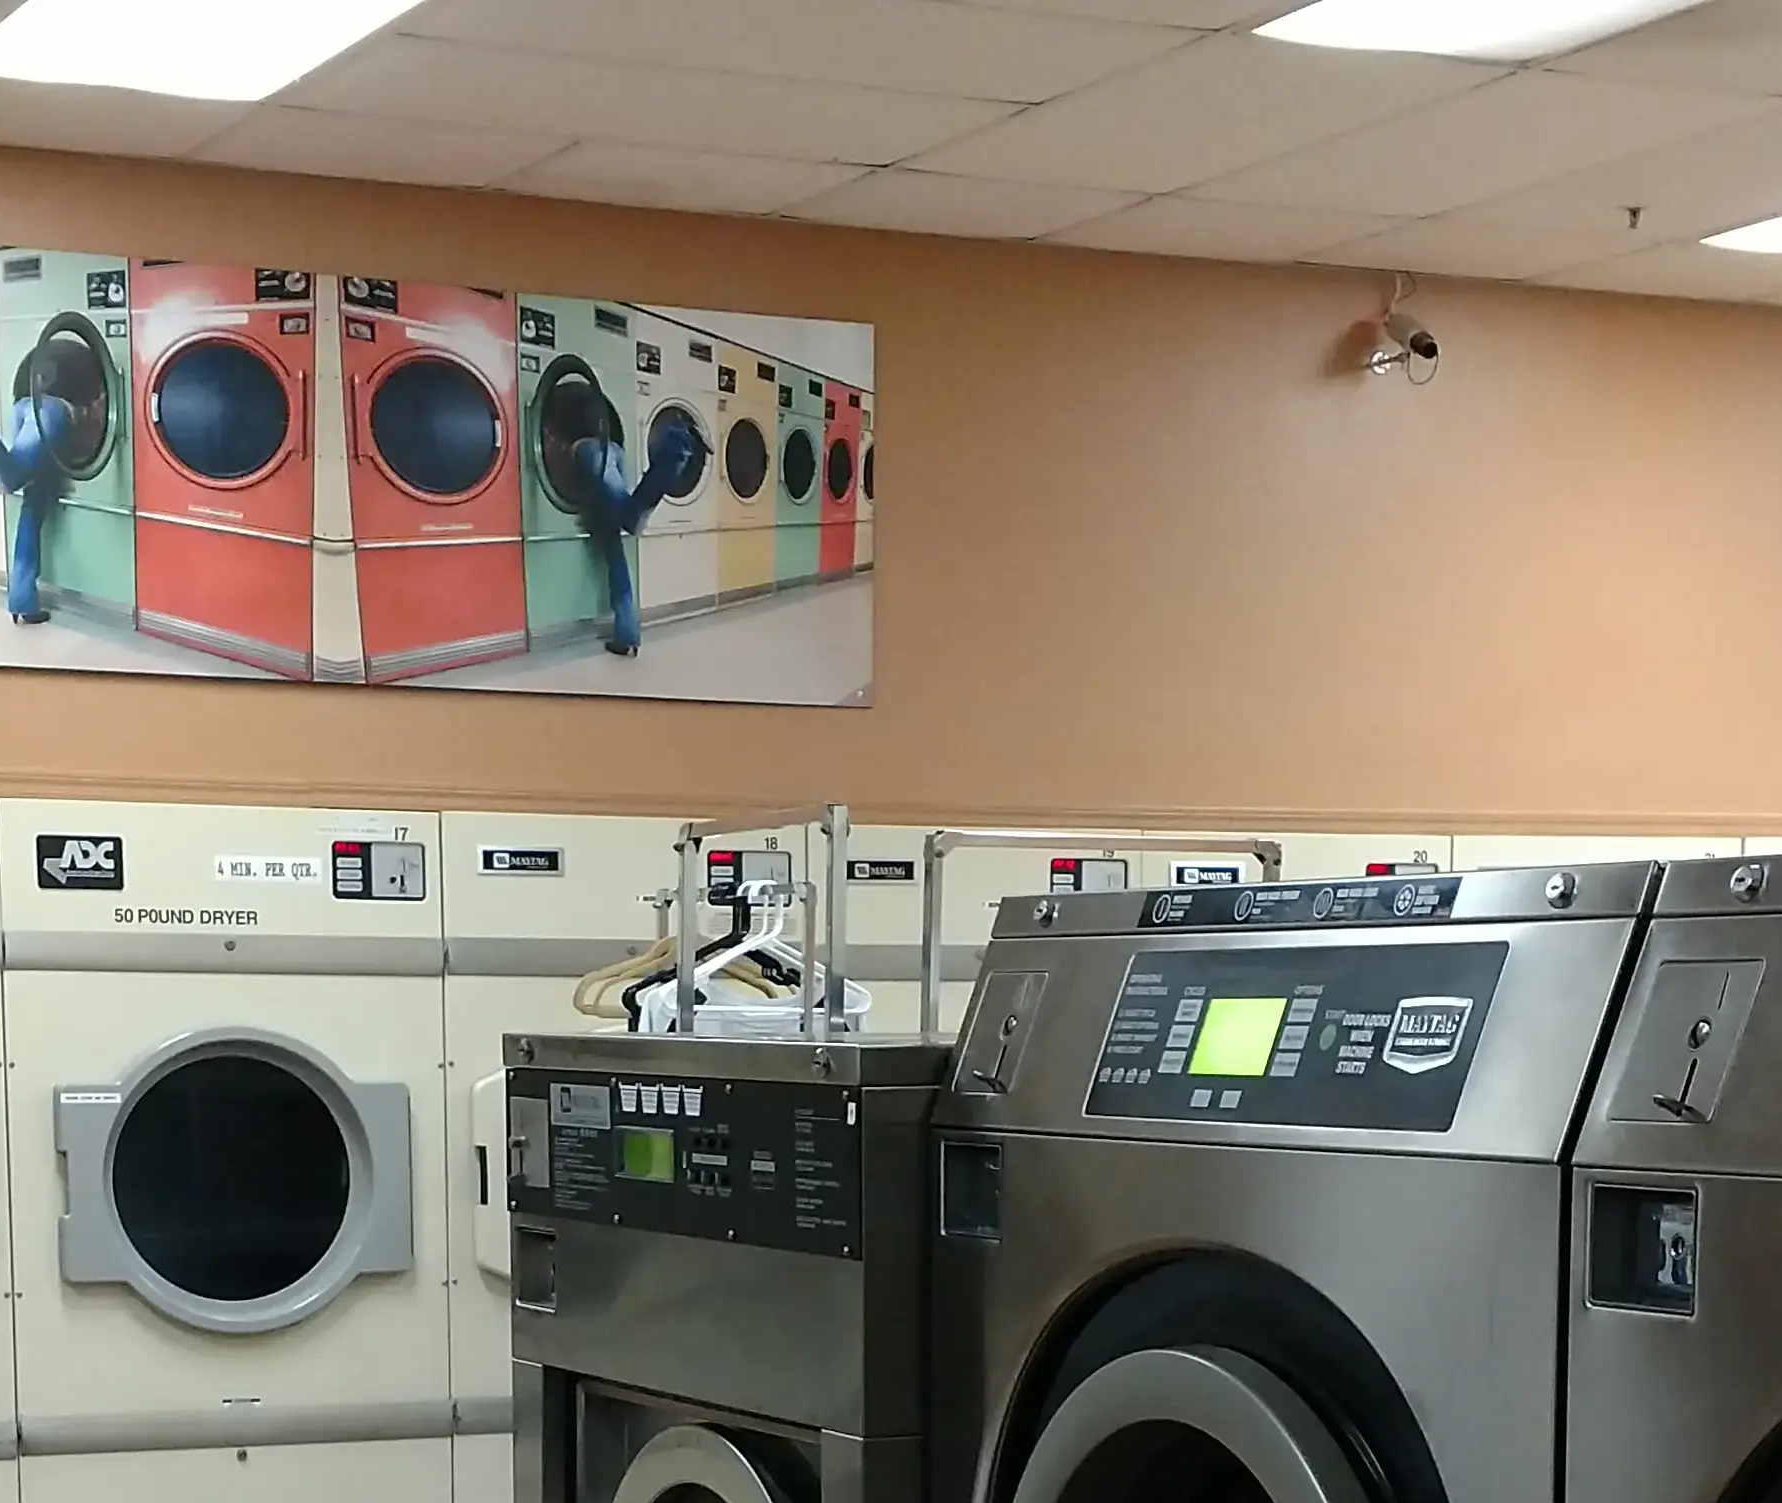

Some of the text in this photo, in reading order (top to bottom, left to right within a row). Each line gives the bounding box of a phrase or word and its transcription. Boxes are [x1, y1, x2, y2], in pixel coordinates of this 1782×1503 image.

[394, 827, 409, 841] 17
[764, 837, 778, 850] 18
[59, 840, 115, 869] ADC
[1413, 850, 1428, 864] 20
[217, 862, 317, 880] 4 MIN. PER QTR.
[114, 908, 258, 926] 50 POUND DRYER
[1399, 1013, 1460, 1034] MAYTAG
